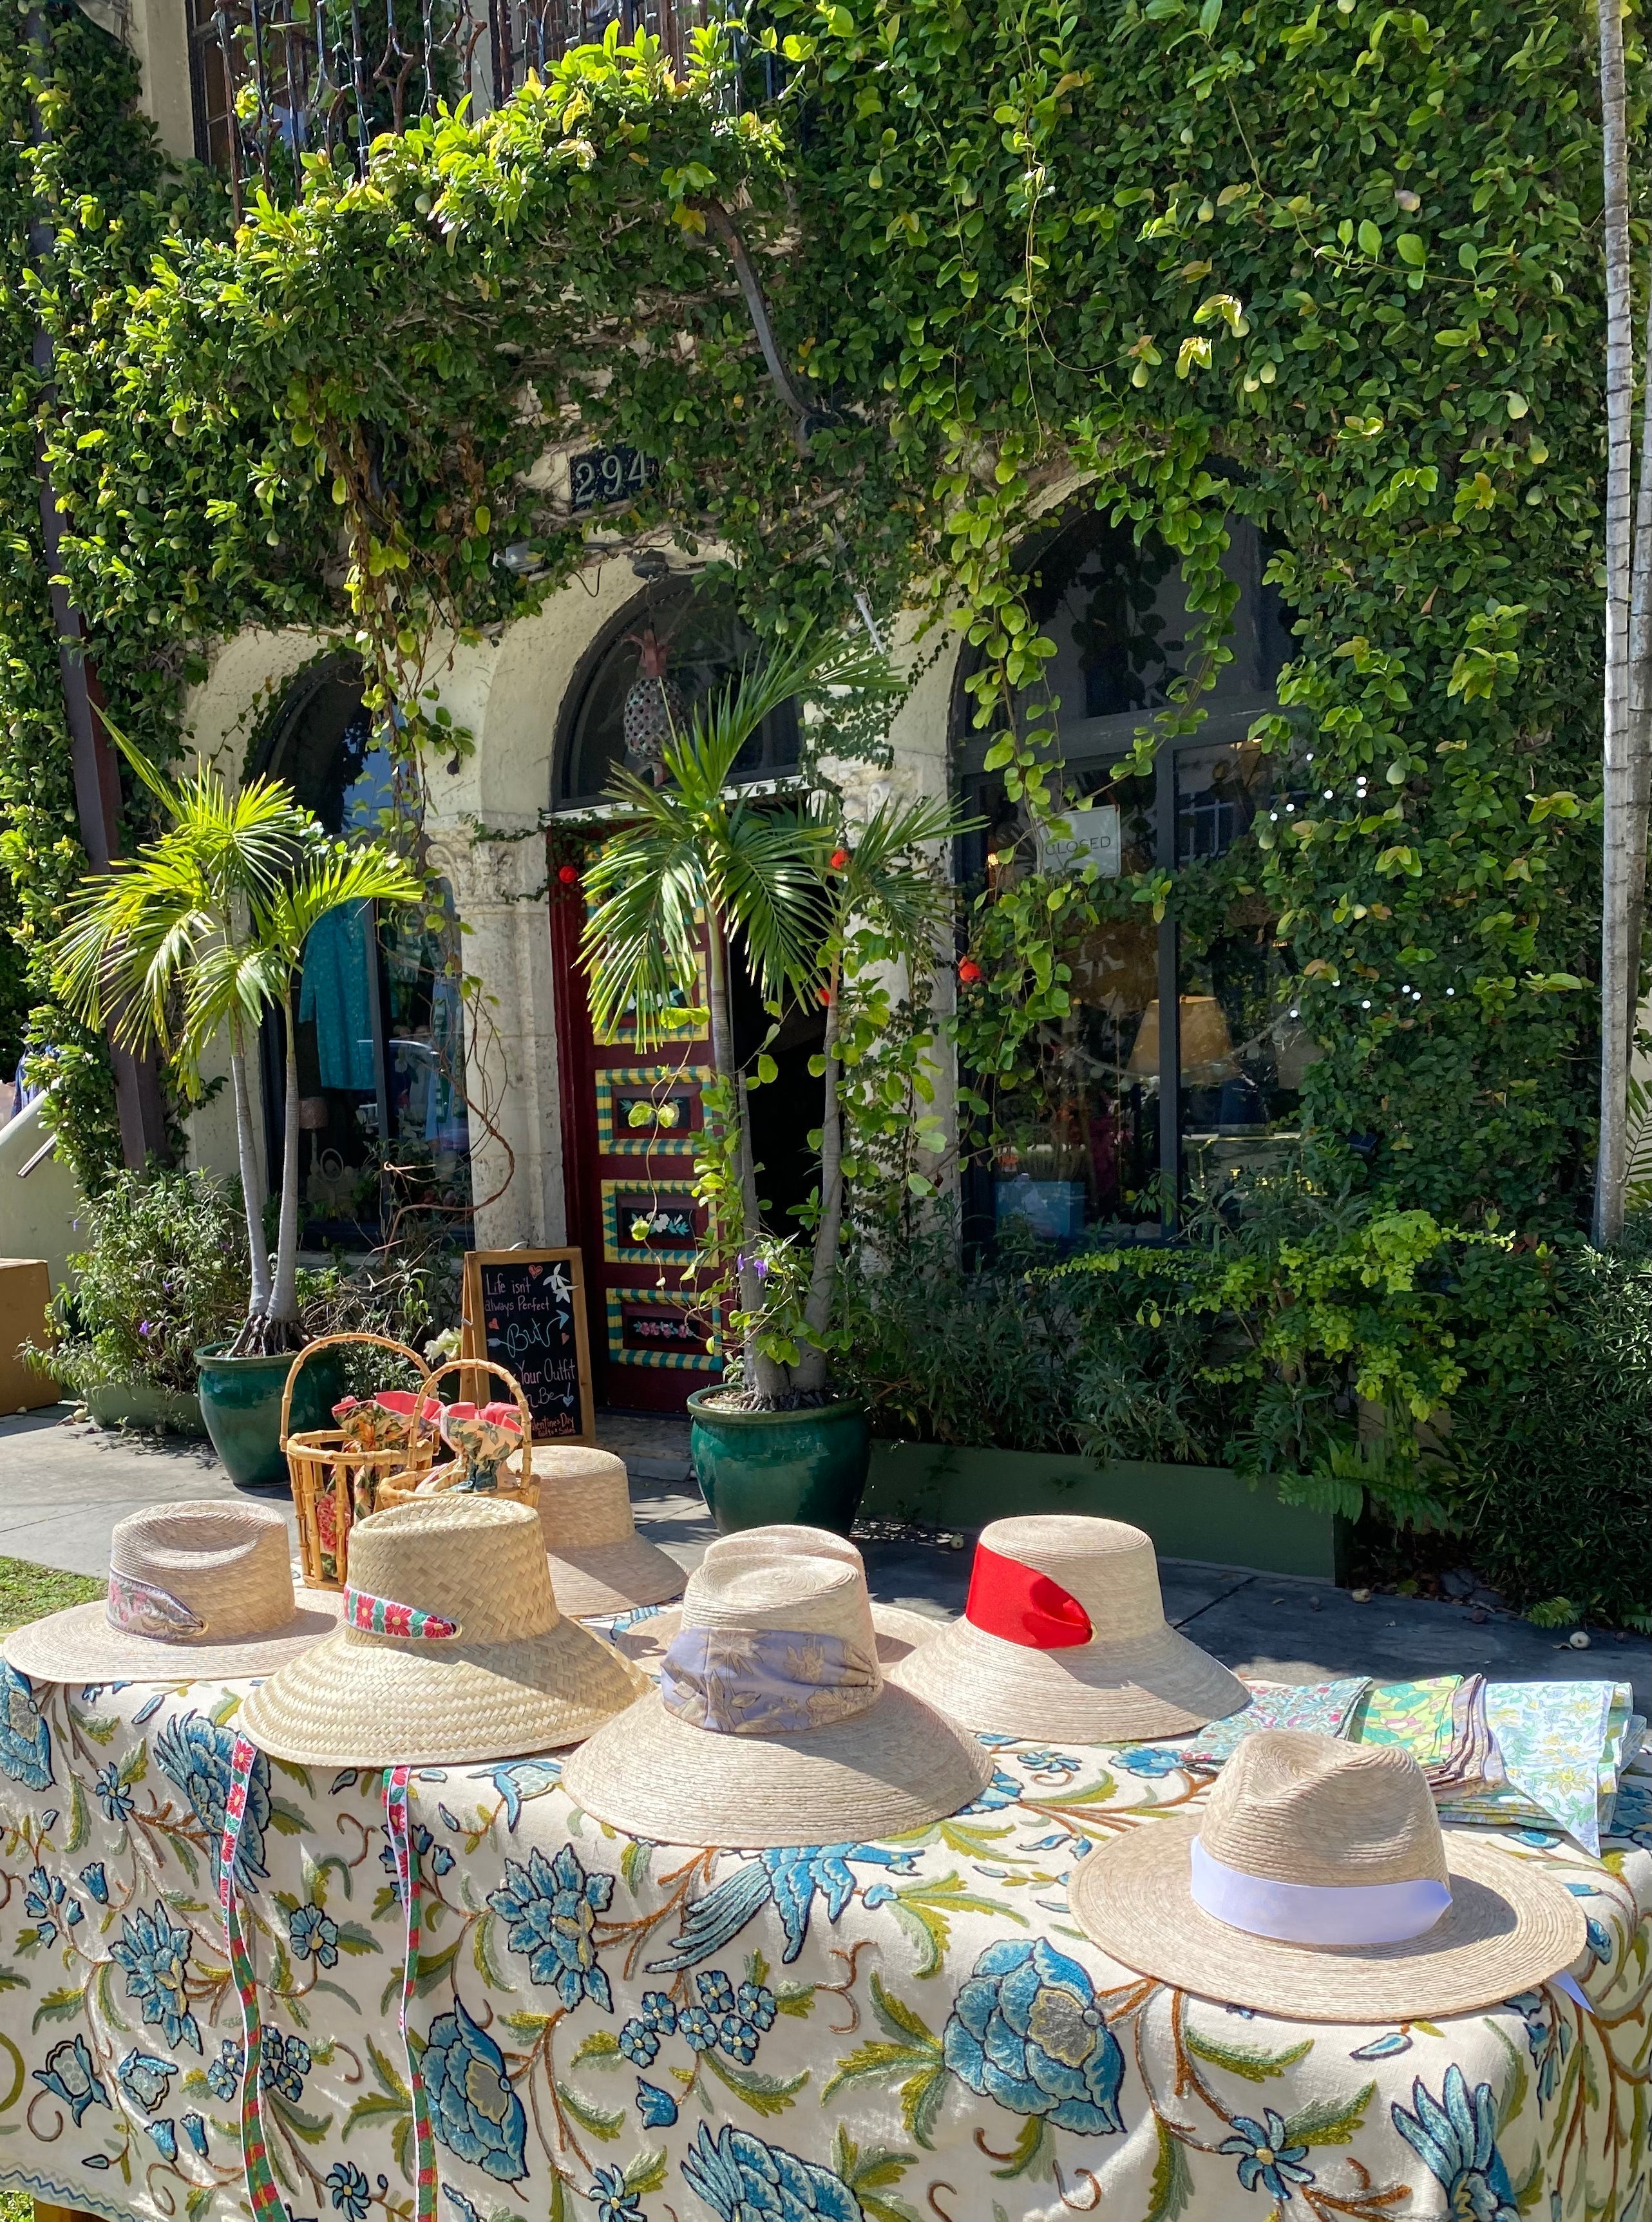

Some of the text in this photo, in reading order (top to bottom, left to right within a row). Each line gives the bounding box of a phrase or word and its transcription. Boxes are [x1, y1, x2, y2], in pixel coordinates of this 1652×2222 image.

[575, 450, 649, 504] 294
[486, 1273, 531, 1295] Life isn't
[484, 1295, 549, 1318] always Perfect
[507, 1318, 542, 1358] But
[515, 1358, 575, 1385] Your Outfit
[538, 1387, 564, 1404] Be
[560, 1412, 574, 1429] Day
